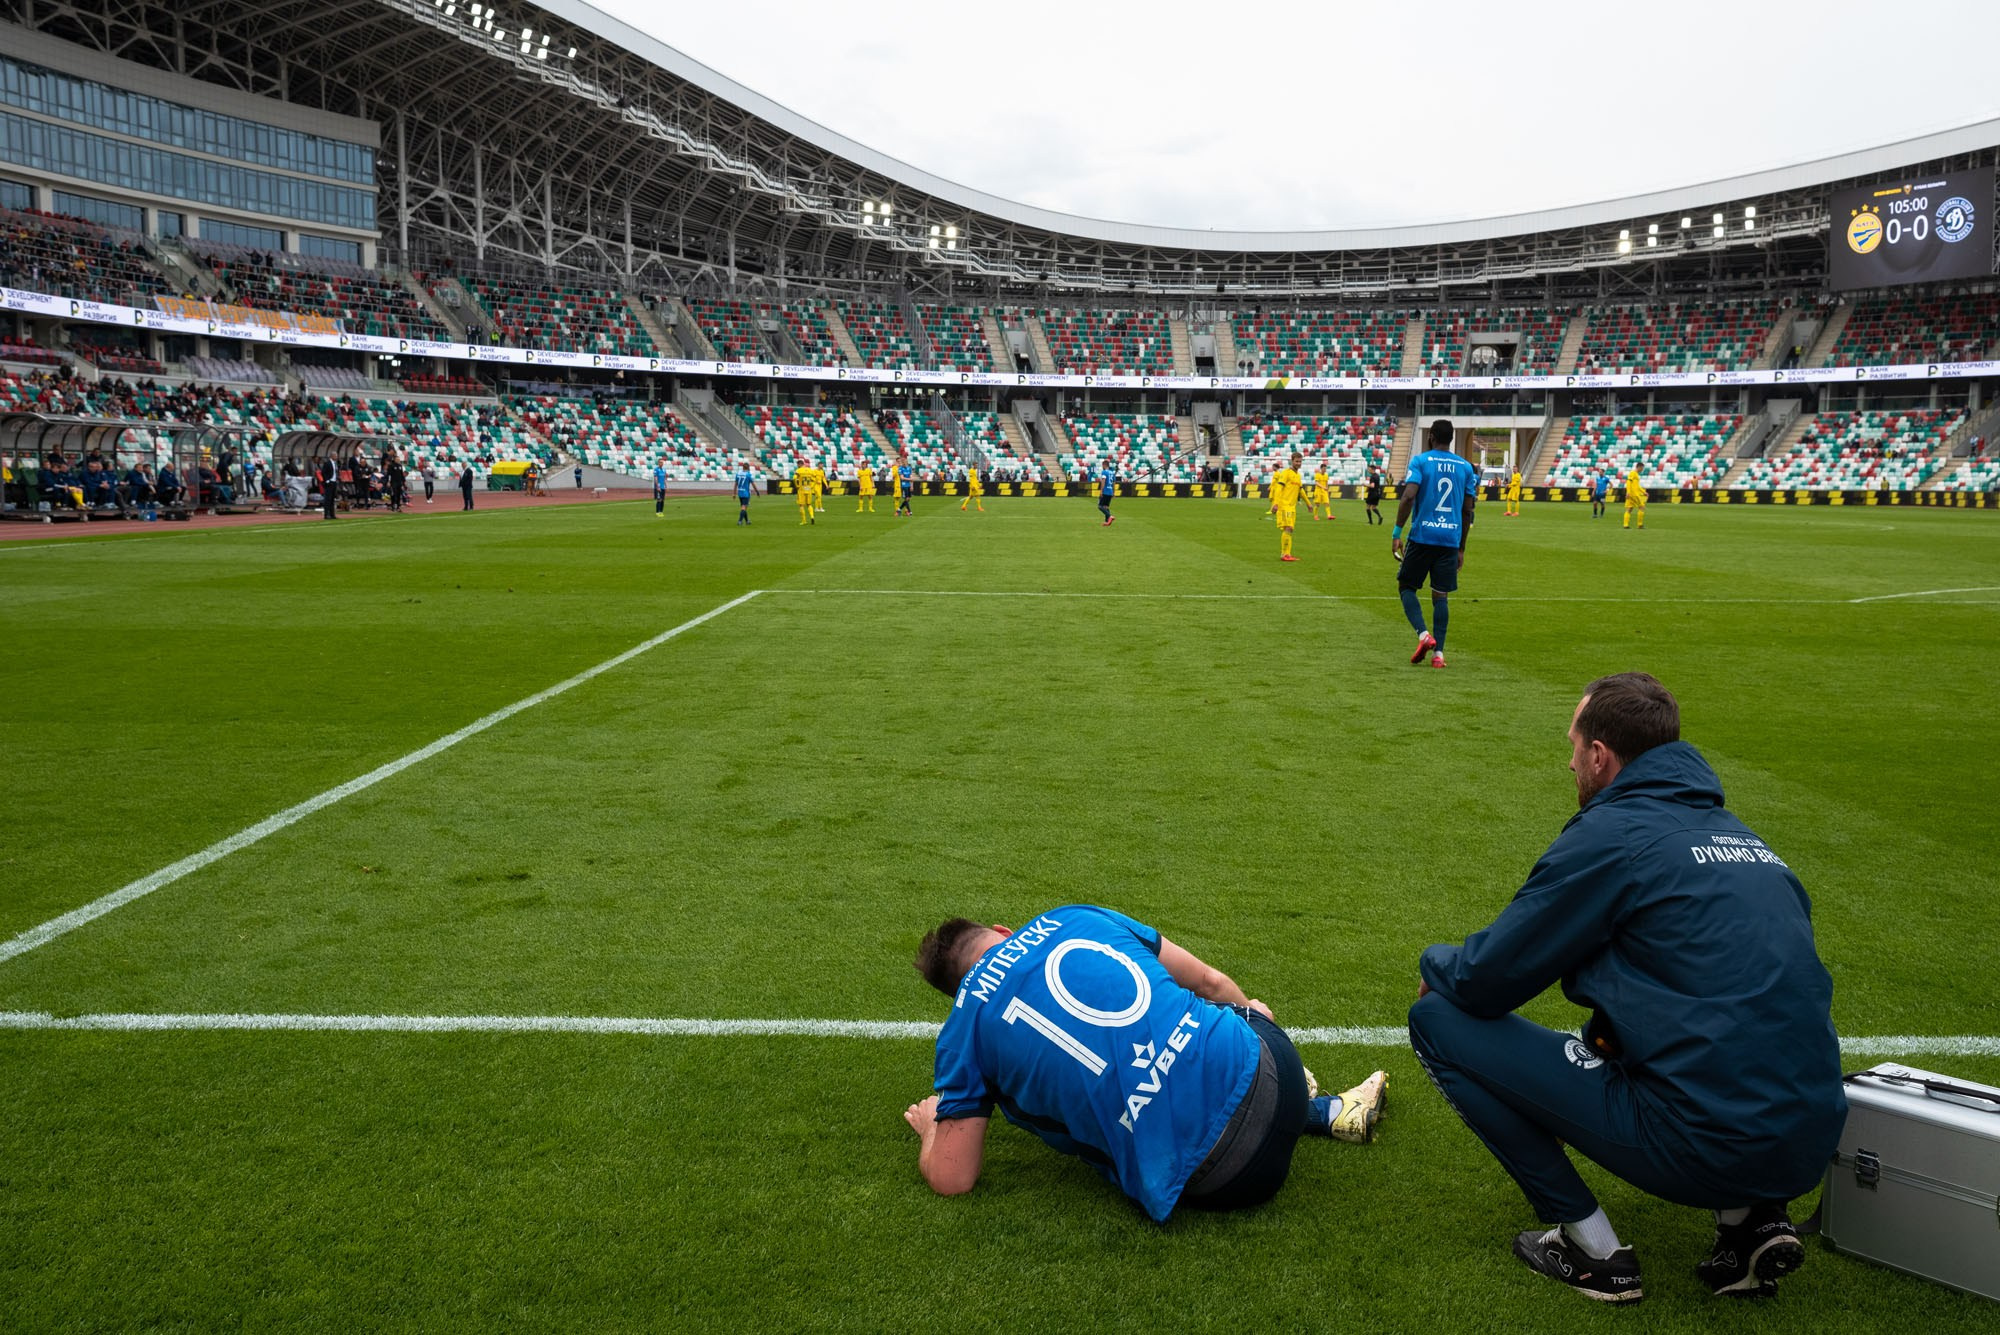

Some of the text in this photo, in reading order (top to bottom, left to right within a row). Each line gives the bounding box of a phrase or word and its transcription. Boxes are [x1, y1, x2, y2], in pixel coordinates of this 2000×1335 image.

[1888, 196, 1928, 215] 105:00
[1886, 215, 1929, 244] 0-0
[7, 290, 52, 303] DEVELOPMENT
[8, 301, 25, 309] BANK
[83, 302, 100, 311] БАНК
[83, 311, 117, 322] РАЗВИТИЯ
[147, 320, 164, 328] BANK
[220, 328, 253, 337] РАЗВИТИЯ
[282, 335, 297, 343] BANK
[352, 342, 383, 350] РАЗВИТИЯ
[411, 340, 452, 349] DEVELOPMENT
[537, 350, 577, 359] DEVELOPMENT
[661, 359, 700, 367] DEVELOPMENT
[1788, 368, 1837, 376] DEVELOPMENT
[1643, 373, 1689, 381] DEVELOPMENT
[1437, 462, 1455, 474] KIKI
[1435, 477, 1453, 512] 2
[1422, 520, 1459, 530] FAVBET
[1711, 835, 1748, 846] FOOTBALL
[1690, 846, 1756, 864] DYNAMO
[1001, 938, 1152, 1077] 10
[1118, 1011, 1201, 1134] FAVBET
